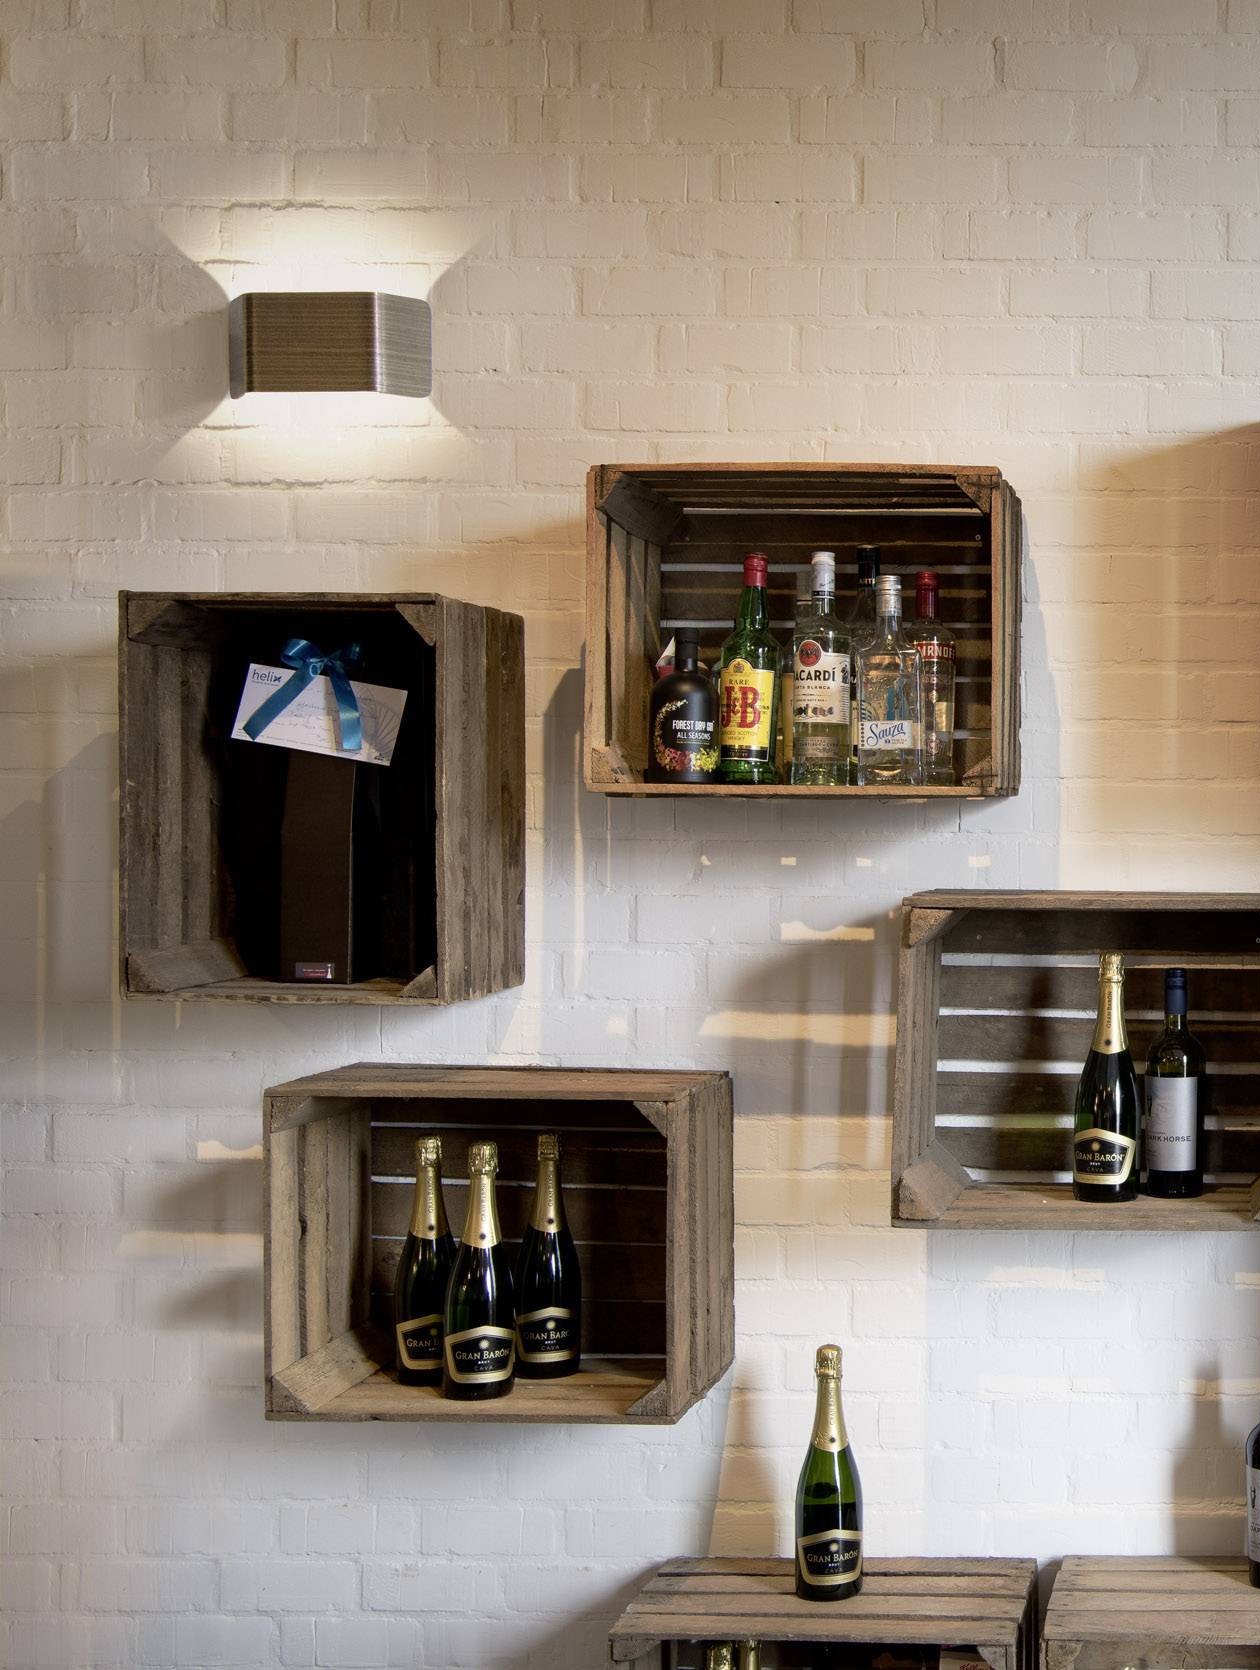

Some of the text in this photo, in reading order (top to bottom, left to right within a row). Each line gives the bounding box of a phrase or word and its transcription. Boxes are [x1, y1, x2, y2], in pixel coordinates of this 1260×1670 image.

[252, 669, 283, 684] helix
[794, 667, 836, 682] ACARDÍ
[729, 678, 750, 686] RARE
[672, 720, 695, 730] FOREST
[677, 731, 687, 739] ALL
[688, 732, 711, 741] SEASONS
[866, 722, 906, 747] Sauza
[1163, 1135, 1192, 1143] HORSE
[406, 1338, 431, 1348] GRAN
[455, 1348, 511, 1361] GRAN BARÓN
[807, 1549, 858, 1563] GRAN BARÓN
